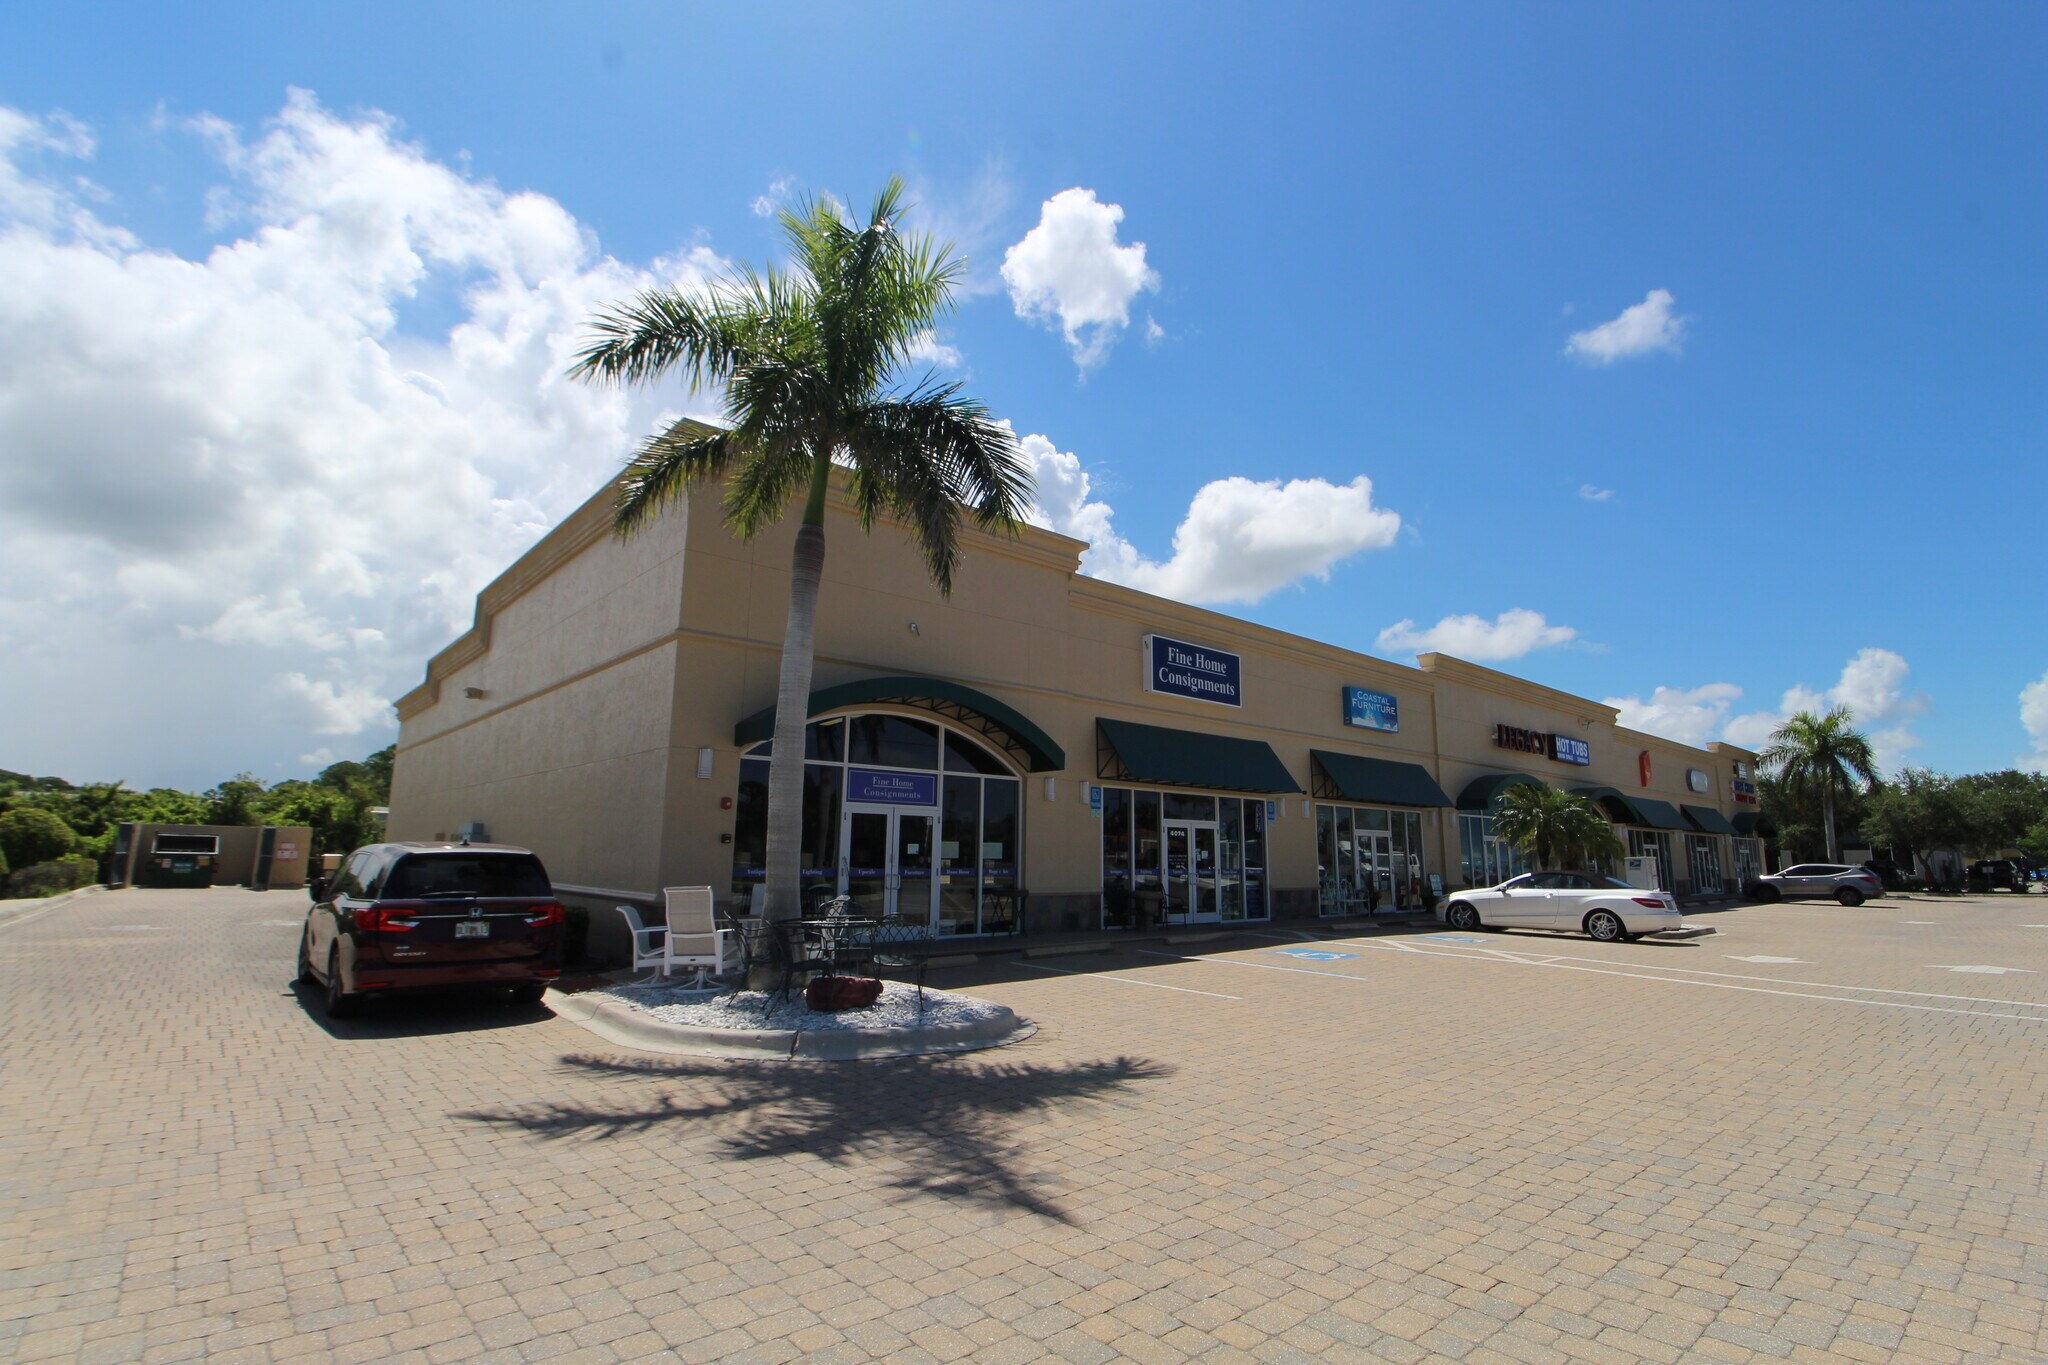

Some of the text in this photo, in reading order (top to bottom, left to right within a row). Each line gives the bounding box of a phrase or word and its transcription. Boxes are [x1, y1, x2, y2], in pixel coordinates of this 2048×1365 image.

[1167, 647, 1227, 674] Fine Home
[1158, 667, 1235, 696] Consignments
[1352, 698, 1396, 716] FURNITURE
[1357, 690, 1391, 706] COASTAL
[1496, 724, 1549, 756] LEGACY
[1556, 737, 1588, 758] HOT TUBS
[872, 776, 914, 788] Fine Home
[864, 787, 921, 800] Consignments
